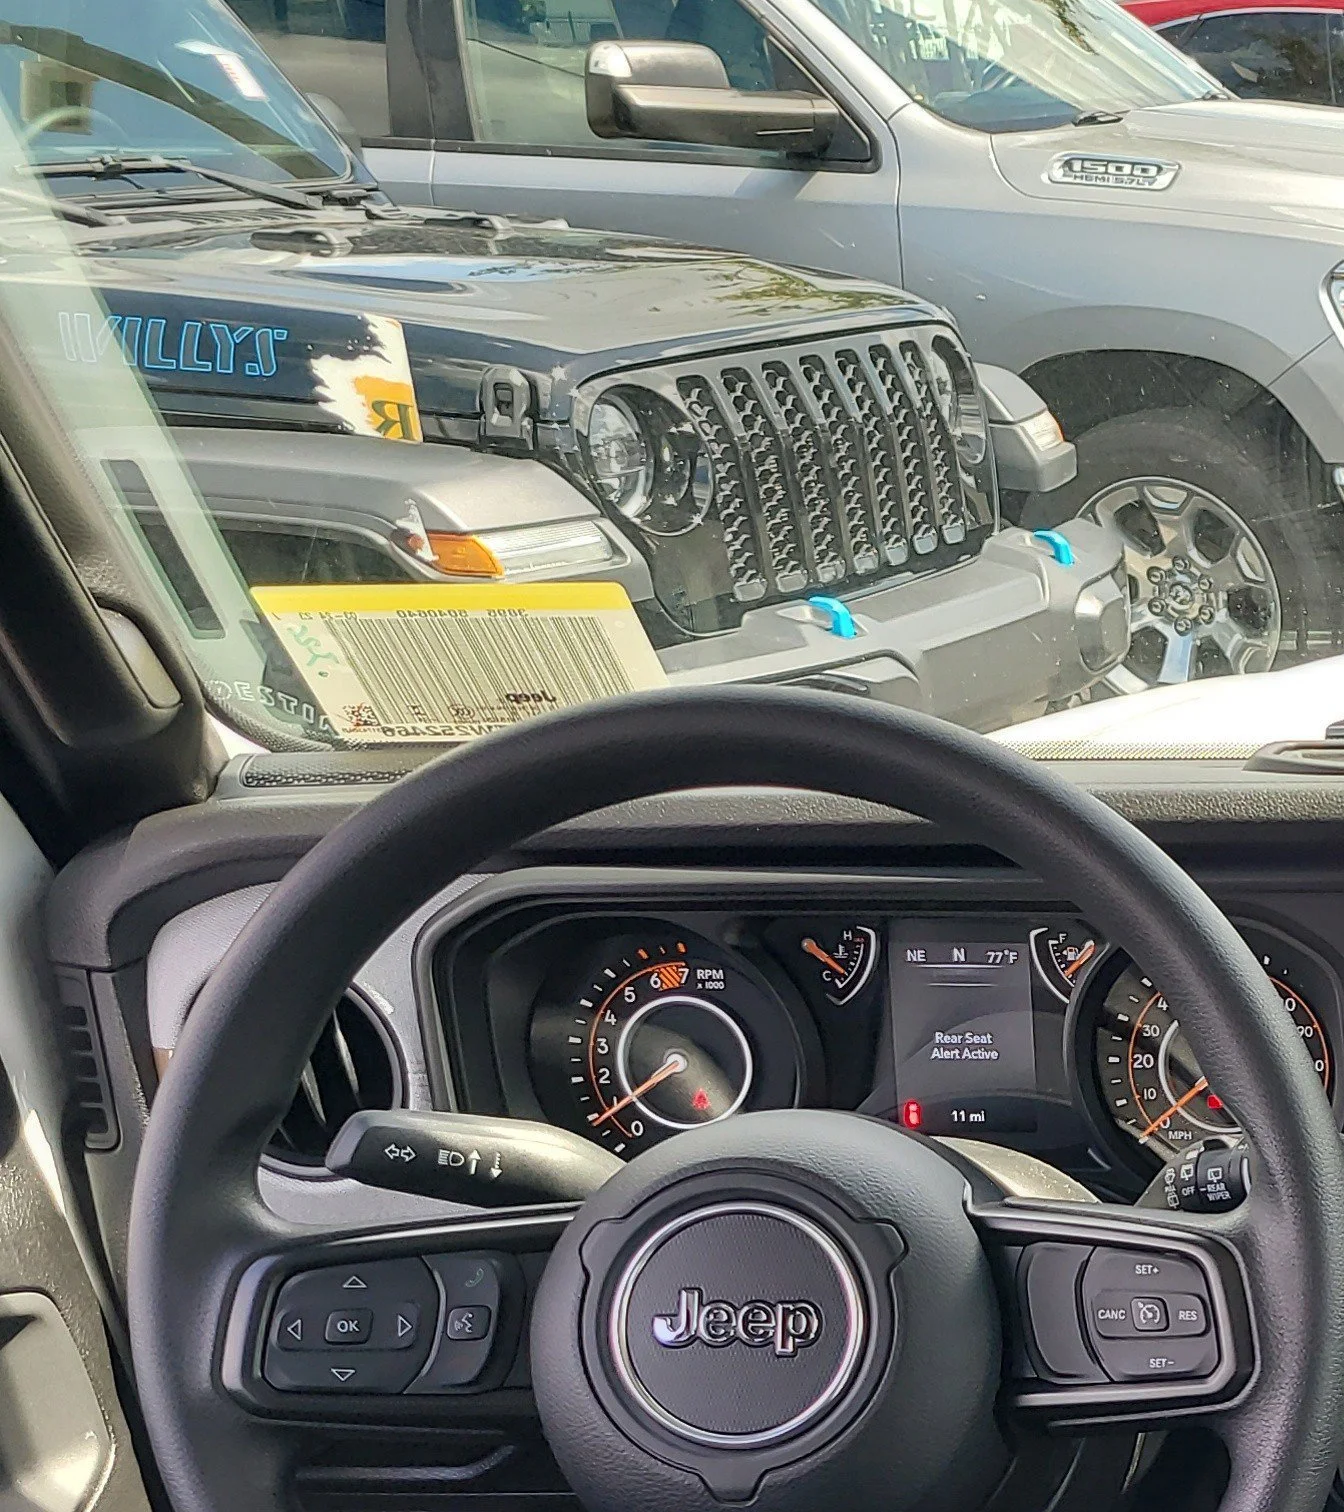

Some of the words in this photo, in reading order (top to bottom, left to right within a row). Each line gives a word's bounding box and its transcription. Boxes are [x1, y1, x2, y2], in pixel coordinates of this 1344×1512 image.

[1070, 159, 1158, 177] 1500
[58, 312, 288, 376] WILLYS
[843, 930, 852, 941] H
[1059, 933, 1067, 943] F
[906, 949, 927, 962] NE
[952, 949, 966, 962] N
[650, 972, 661, 989] 6
[679, 968, 689, 984] 7
[696, 969, 724, 980] RPM
[822, 971, 832, 982] C
[624, 986, 636, 1003] 5
[604, 1009, 617, 1026] 4
[1142, 1024, 1160, 1037] 30
[1297, 1025, 1313, 1038] 90
[935, 1031, 963, 1045] Rear
[965, 1031, 993, 1045] Seat
[596, 1037, 609, 1054] 3
[930, 1047, 960, 1060] Alert
[962, 1047, 999, 1060] Active
[1132, 1053, 1154, 1069] 20
[599, 1068, 611, 1084] 2
[1143, 1087, 1157, 1100] 10
[950, 1110, 966, 1122] 11
[969, 1110, 986, 1122] mi
[631, 1120, 644, 1137] 0
[1168, 1130, 1193, 1140] MPH
[1182, 1186, 1195, 1196] OFF
[1207, 1183, 1226, 1192] REAR
[1207, 1191, 1232, 1201] WIPER
[1097, 1309, 1126, 1320] CANC
[1178, 1310, 1198, 1321] RES
[336, 1320, 360, 1333] OK
[652, 1287, 824, 1358] Jeep
